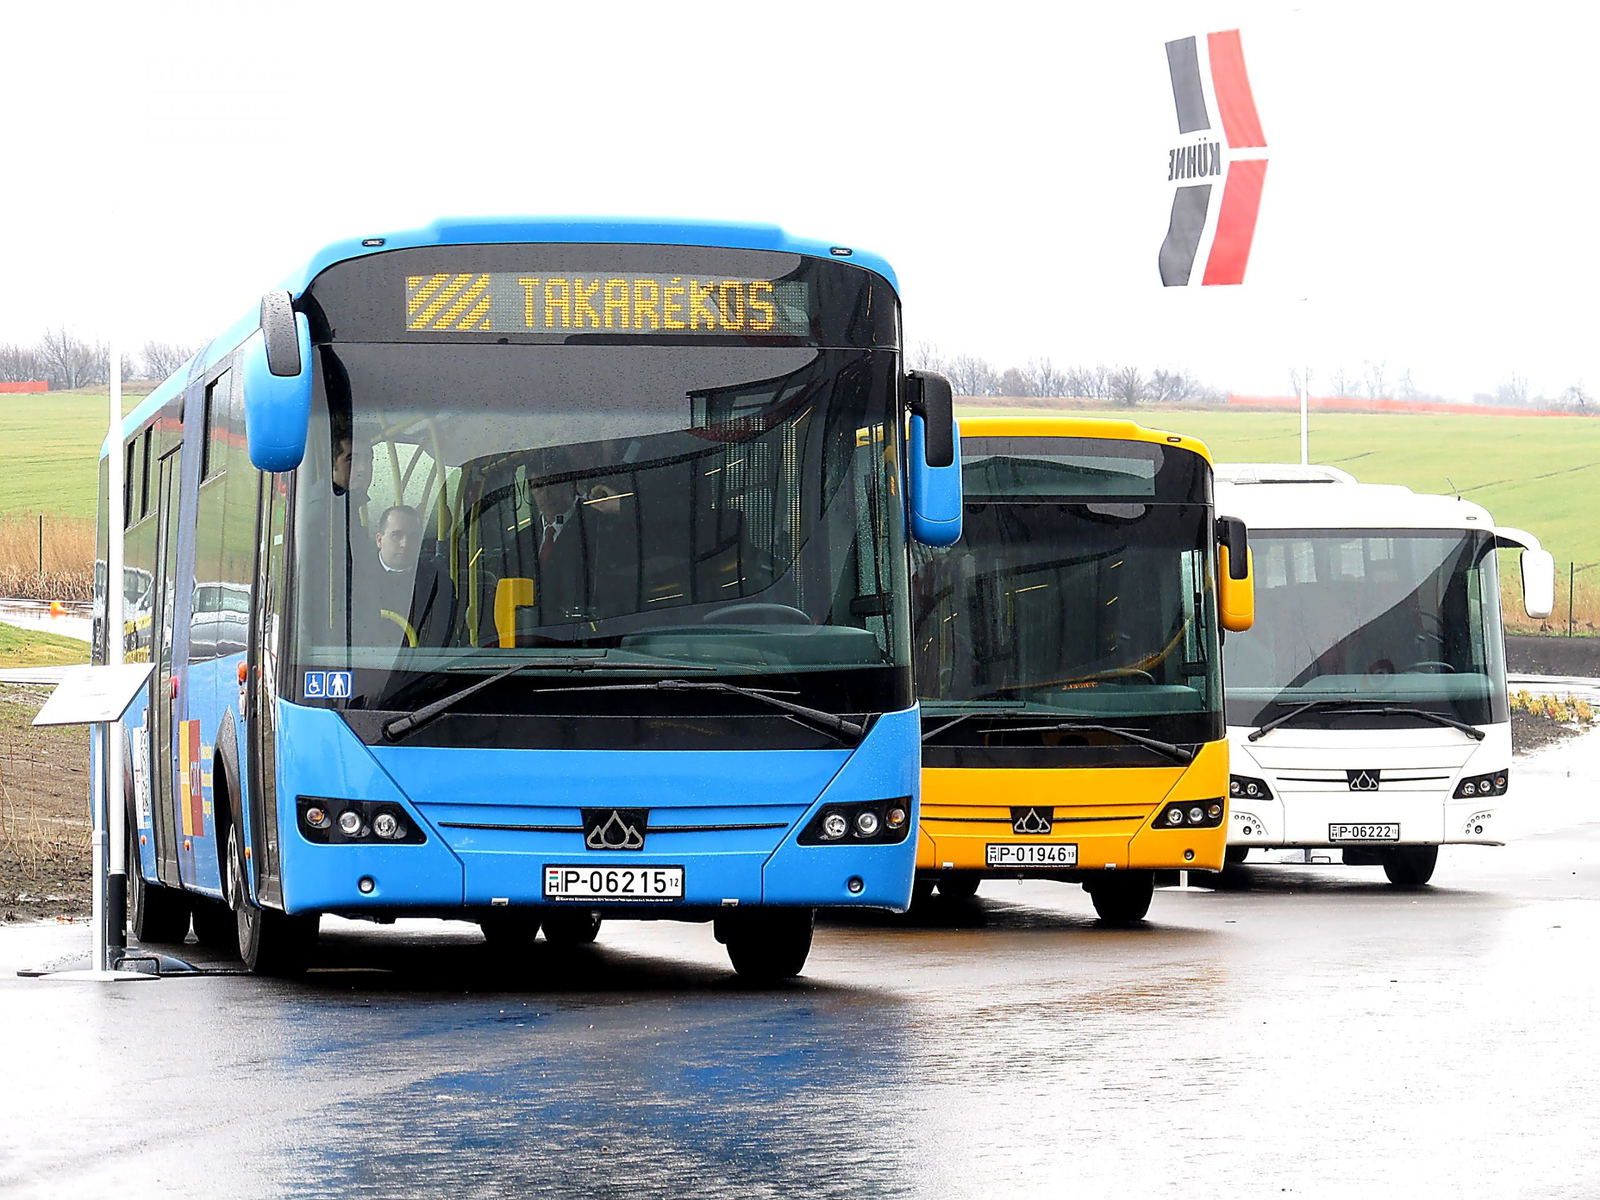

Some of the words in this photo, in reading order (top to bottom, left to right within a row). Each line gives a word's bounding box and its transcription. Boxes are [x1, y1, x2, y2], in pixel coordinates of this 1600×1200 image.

[518, 277, 774, 331] TAKARÉKOS
[1339, 826, 1391, 838] P-06222
[989, 854, 997, 862] H
[1000, 847, 1067, 862] P-01946
[549, 881, 559, 893] H
[564, 870, 667, 893] P-06215
[669, 878, 679, 887] 12
